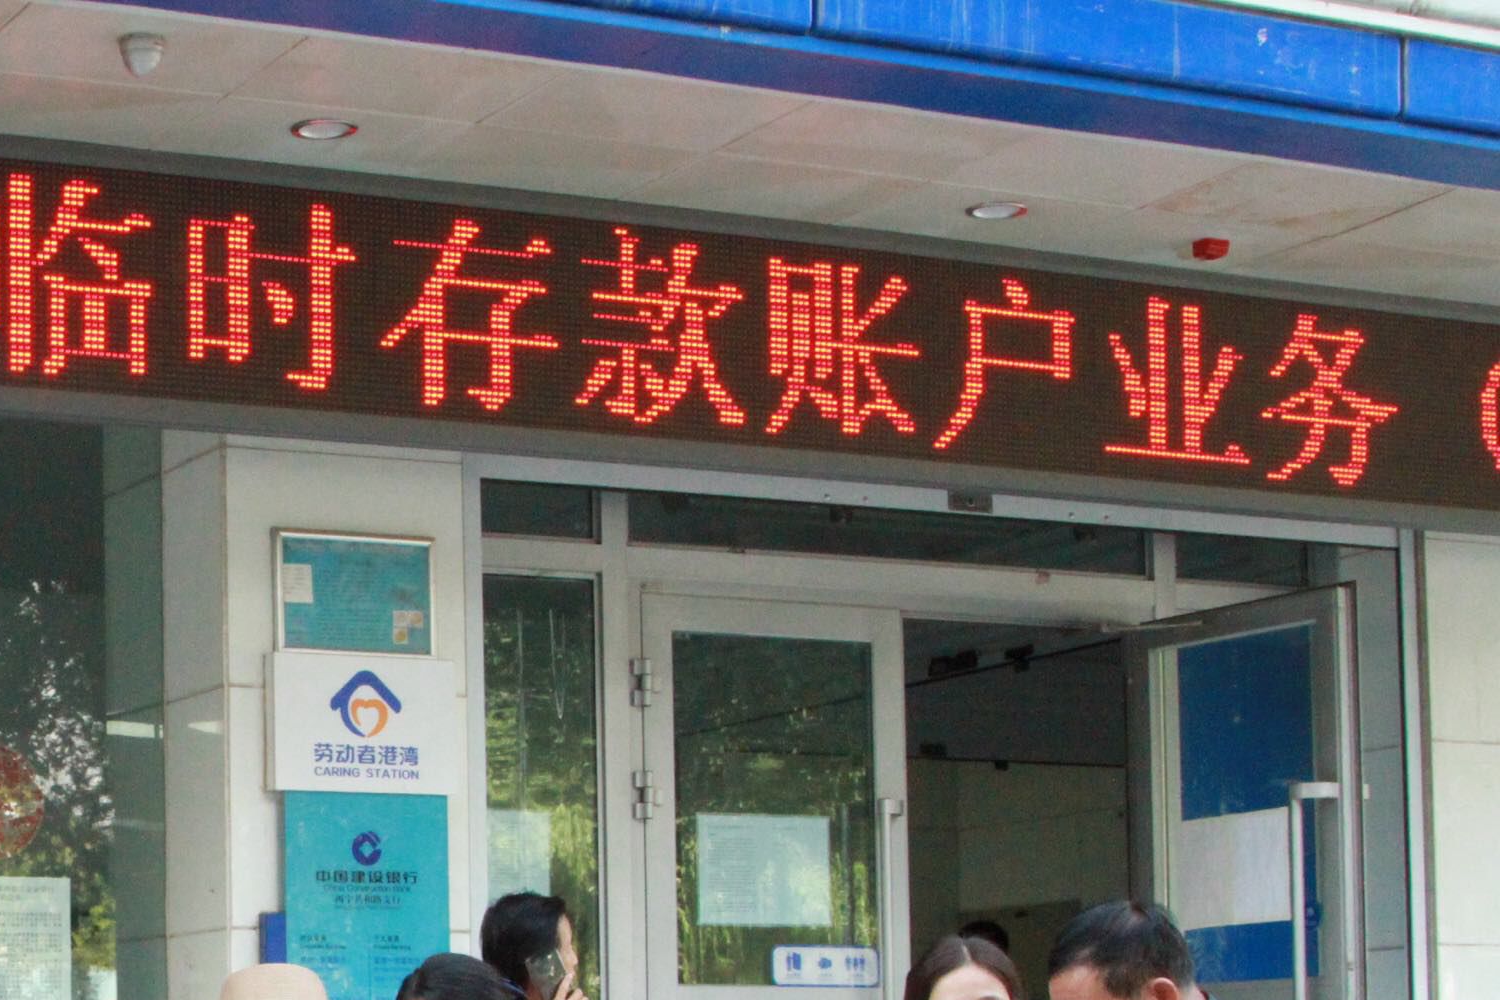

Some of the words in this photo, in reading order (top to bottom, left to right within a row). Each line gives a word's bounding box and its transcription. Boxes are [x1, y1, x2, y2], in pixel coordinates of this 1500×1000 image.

[313, 742, 419, 767] 劳动者港湾
[313, 766, 361, 778] CARING
[365, 768, 419, 780] STATION
[315, 869, 418, 885] 中国建设银行
